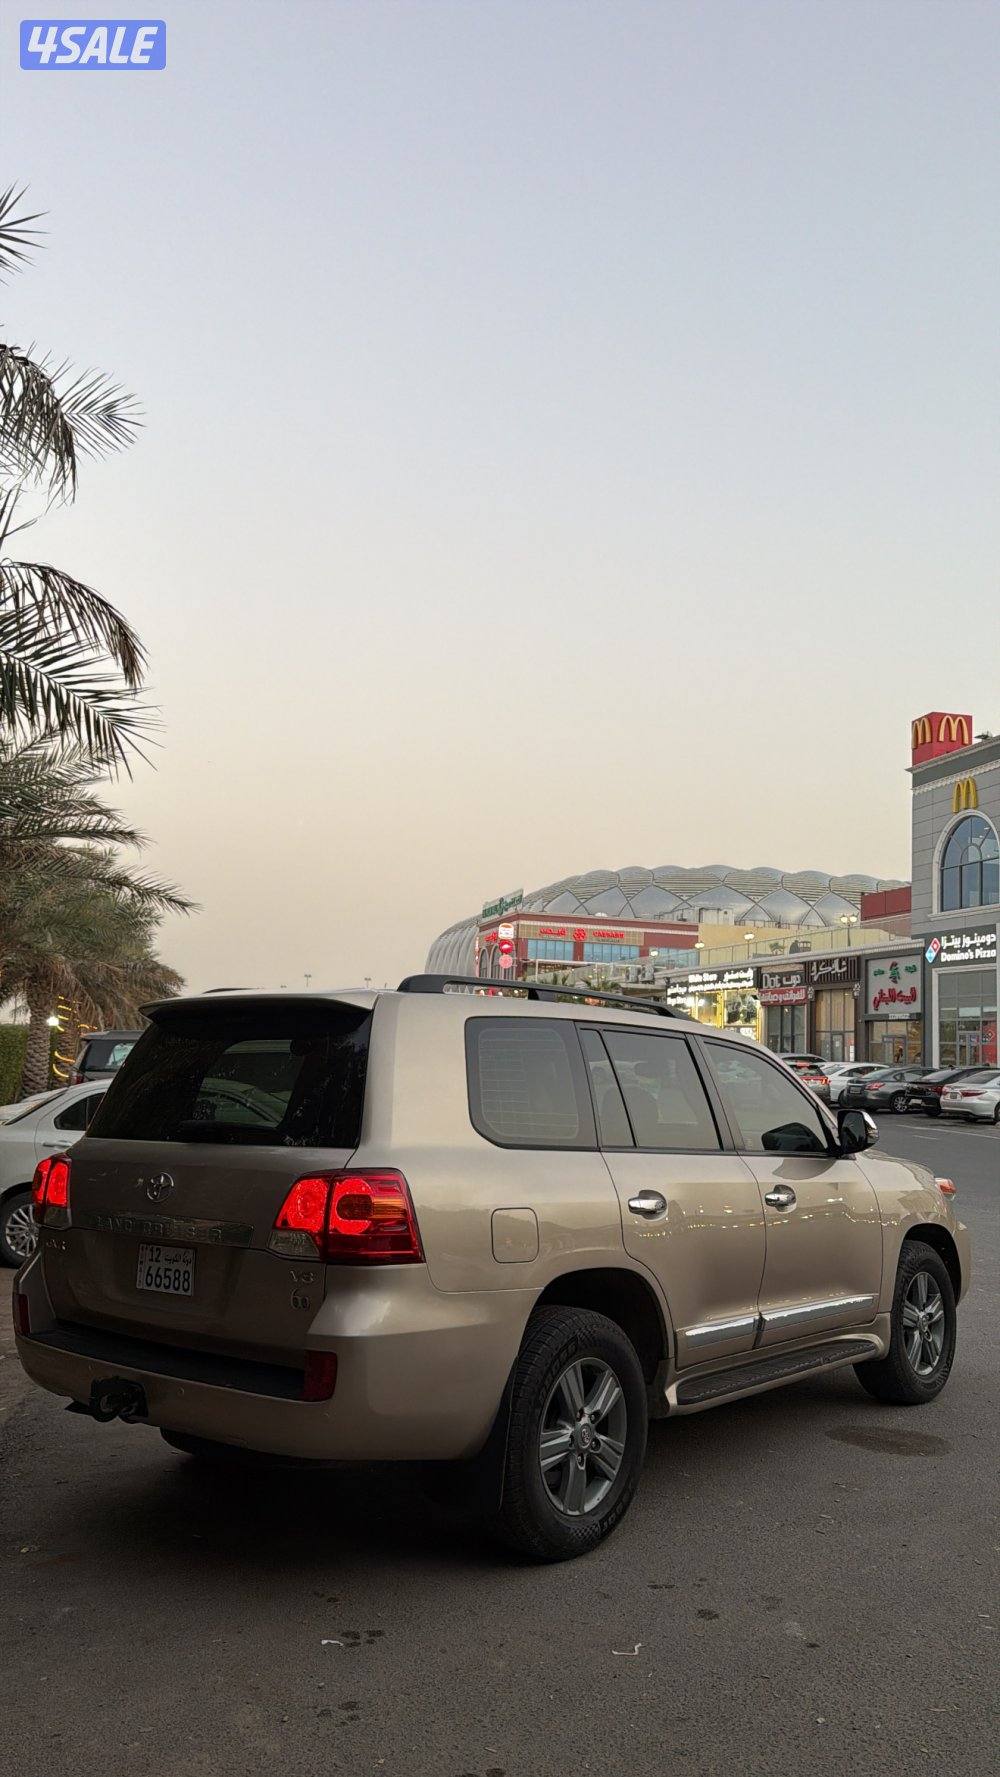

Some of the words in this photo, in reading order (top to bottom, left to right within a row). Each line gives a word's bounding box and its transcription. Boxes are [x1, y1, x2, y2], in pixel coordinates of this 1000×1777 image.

[941, 935, 961, 949] بيتزا
[962, 933, 996, 948] دومينوز
[941, 949, 974, 962] Domino's
[975, 948, 997, 959] Pizza
[762, 973, 781, 989] Dot
[148, 1246, 161, 1263] 12
[145, 1266, 191, 1292] 66588
